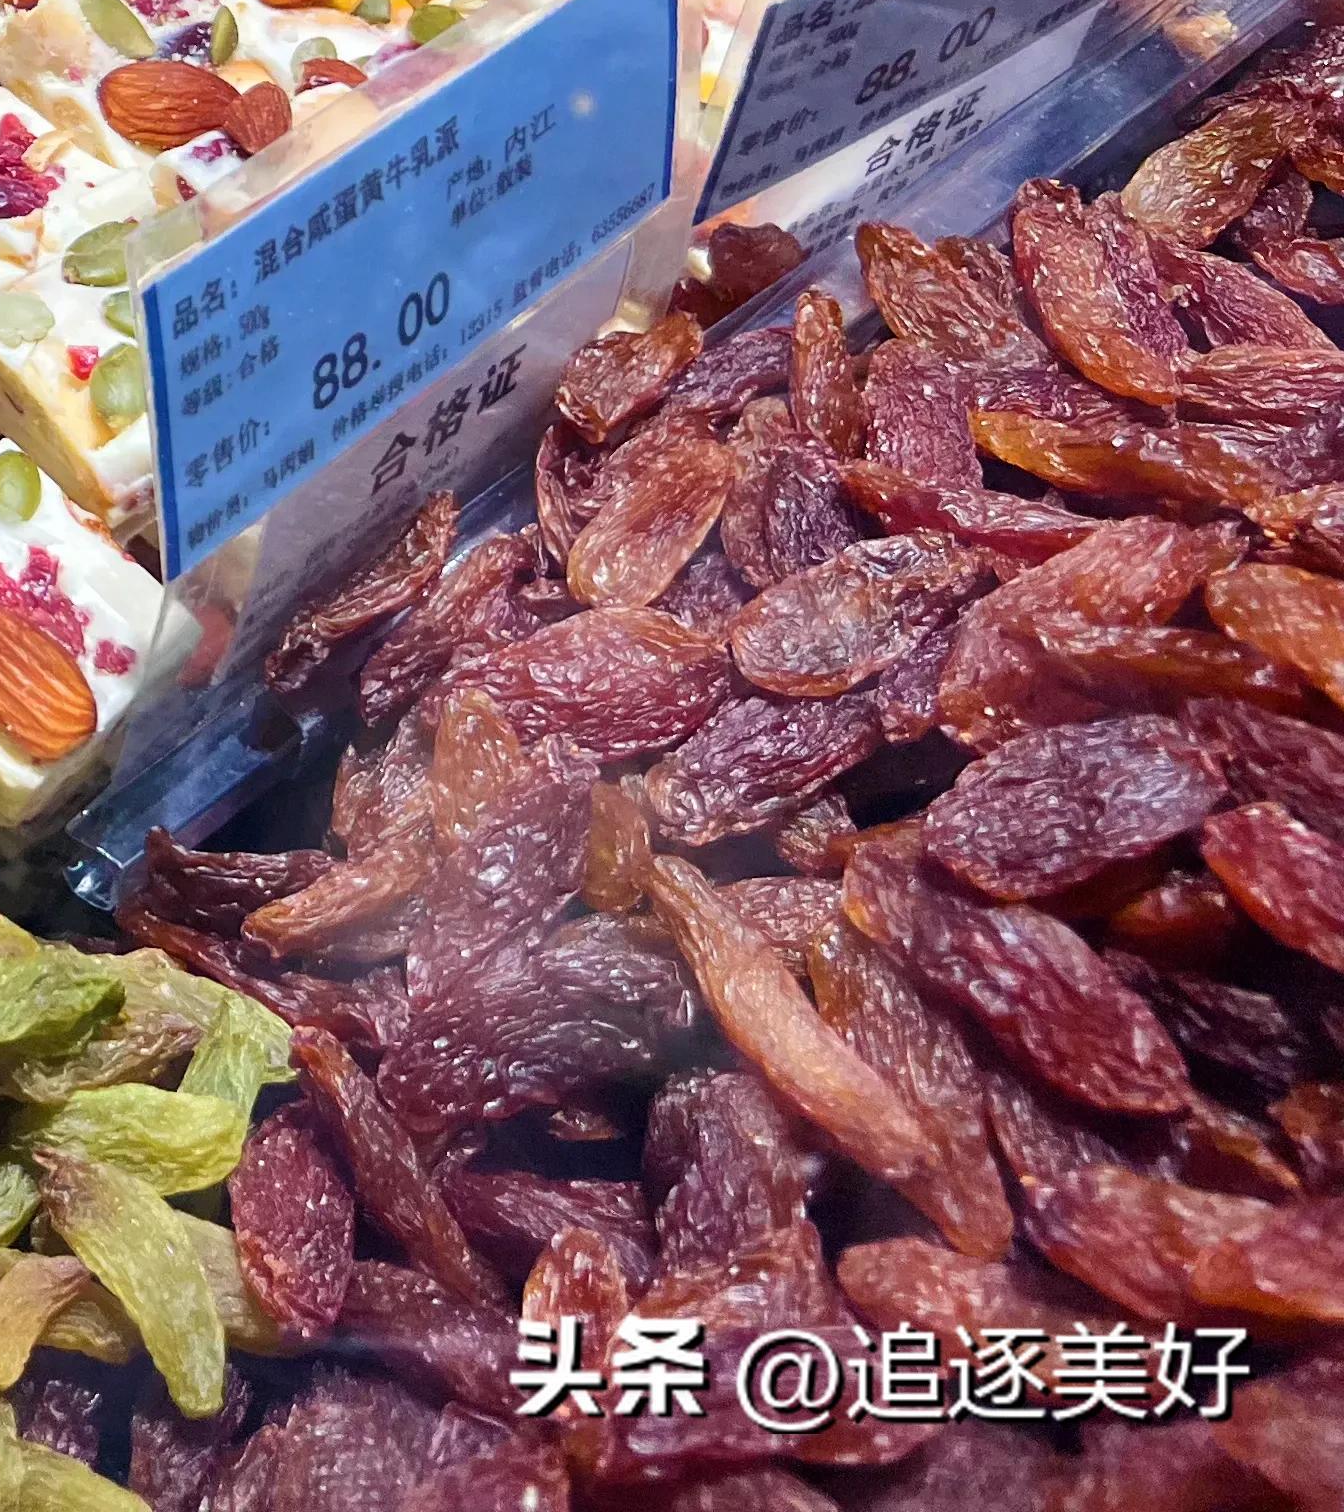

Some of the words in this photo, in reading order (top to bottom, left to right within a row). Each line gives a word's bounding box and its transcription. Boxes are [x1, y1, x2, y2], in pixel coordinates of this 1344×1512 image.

[865, 85, 987, 177] 合格证
[370, 343, 528, 497] 合格证
